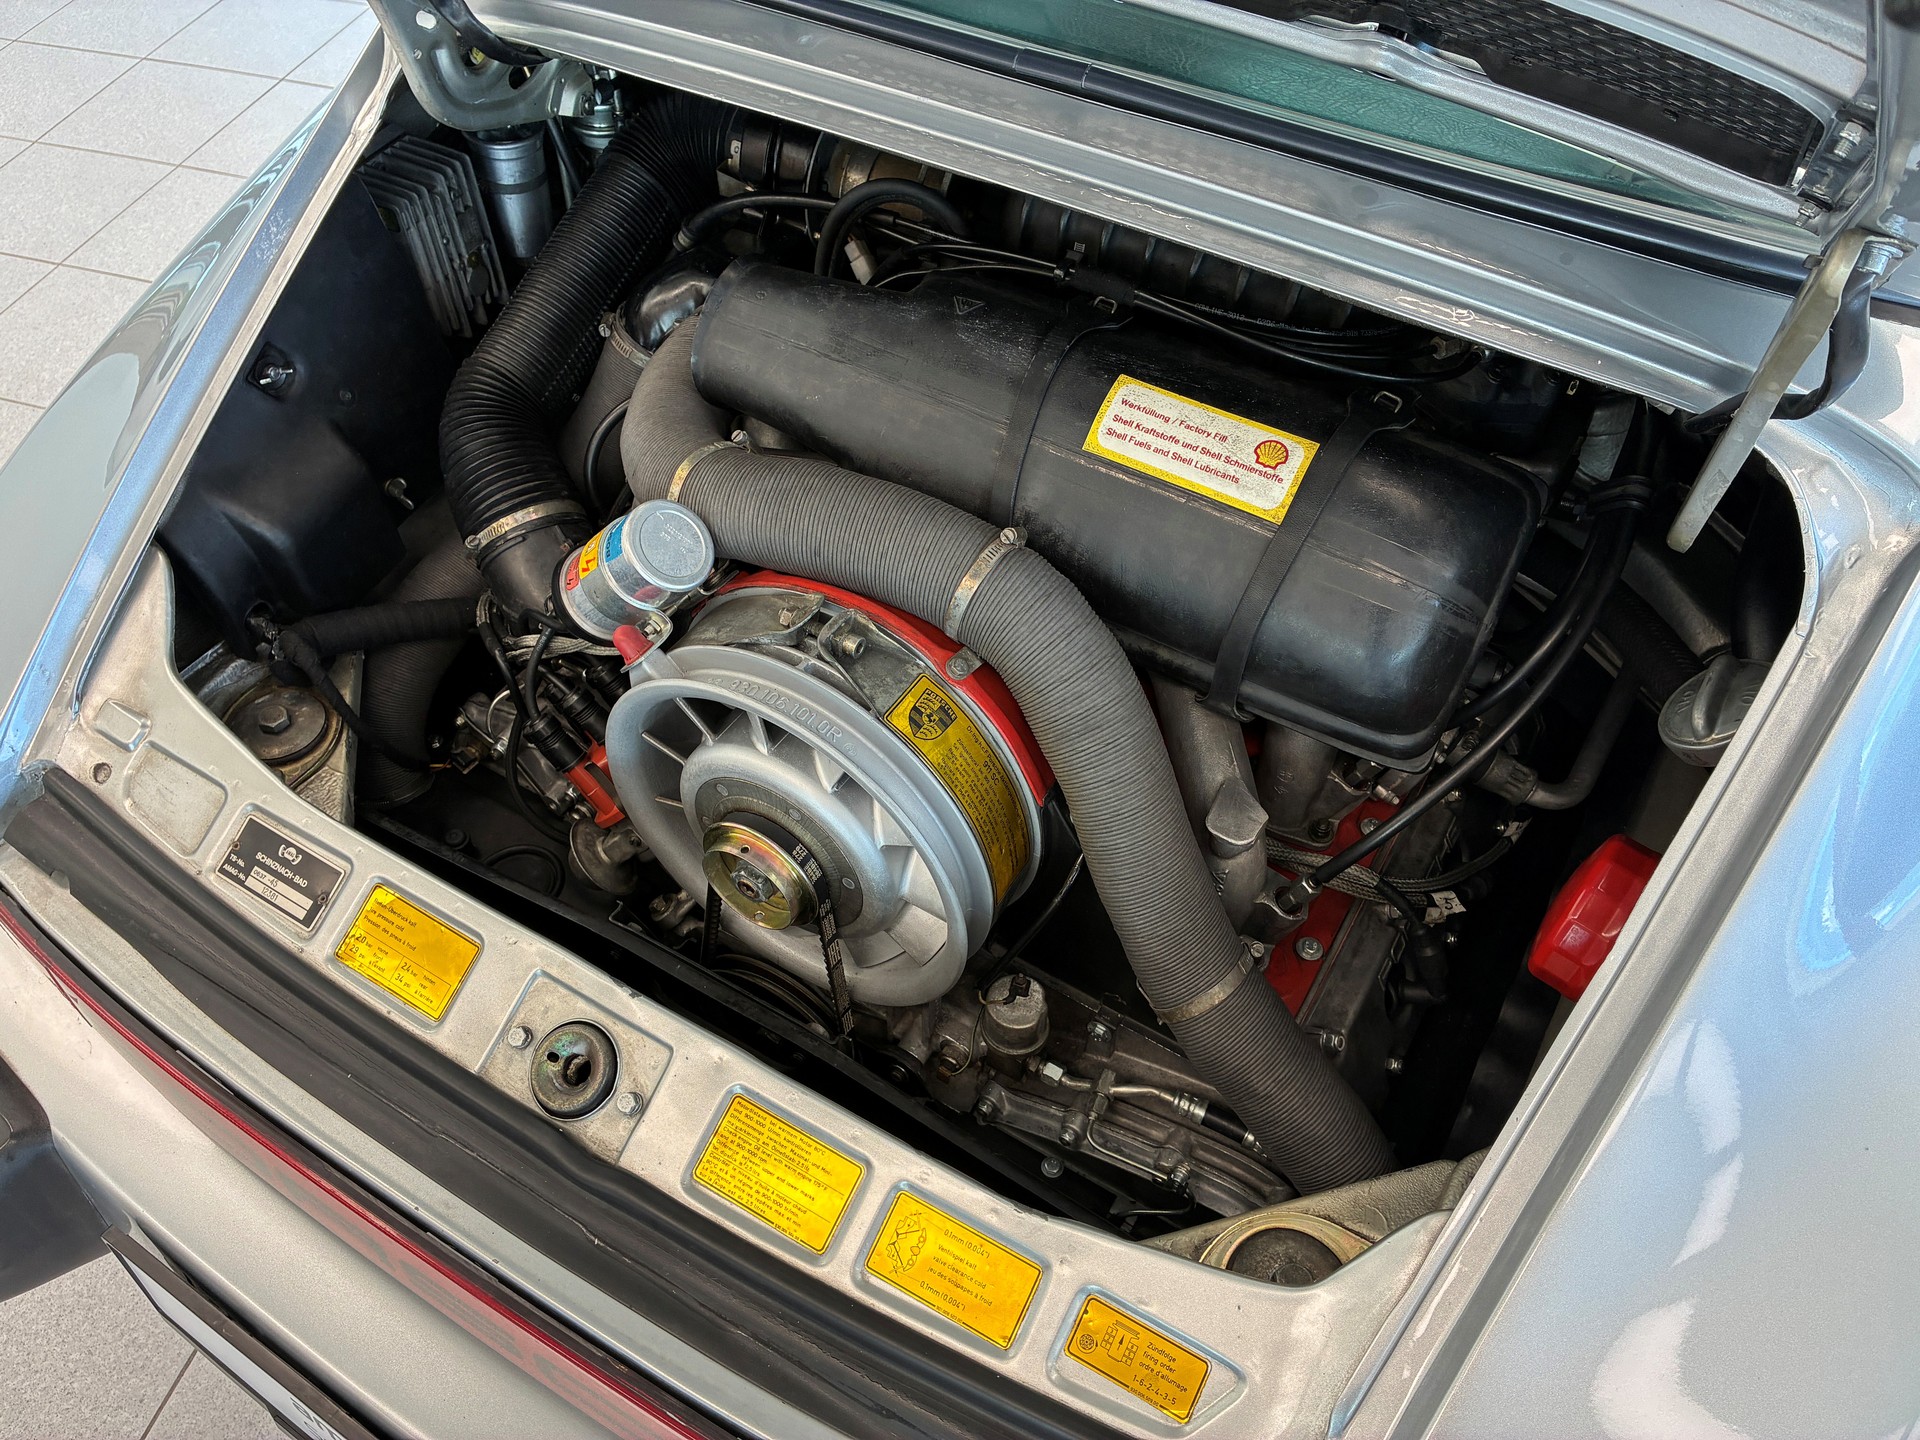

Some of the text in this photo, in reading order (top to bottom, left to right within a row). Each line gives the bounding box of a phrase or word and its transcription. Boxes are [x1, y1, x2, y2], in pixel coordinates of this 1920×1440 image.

[1178, 419, 1212, 438] Factory
[1212, 432, 1227, 442] Fill
[1105, 427, 1239, 483] Shell Fuels and Shell Lubricants
[1112, 414, 1283, 483] Shell Kraftstoffe und Shell Schmierstoffe
[925, 689, 957, 720] PORSCHE
[982, 759, 999, 786] 911 SC
[363, 914, 380, 928] Pression
[376, 912, 394, 925] pressure
[394, 924, 404, 932] cold
[348, 943, 359, 954] 29
[394, 972, 404, 982] 34
[733, 1107, 742, 1115] und
[798, 1137, 812, 1148] Motor
[932, 1255, 986, 1289] valve clearance cold
[978, 1294, 992, 1306] froid
[1142, 1350, 1158, 1365] firing
[1159, 1361, 1176, 1373] order
[1146, 1341, 1176, 1362] Zündfolge
[1138, 1361, 1187, 1392] ordre d'allumage
